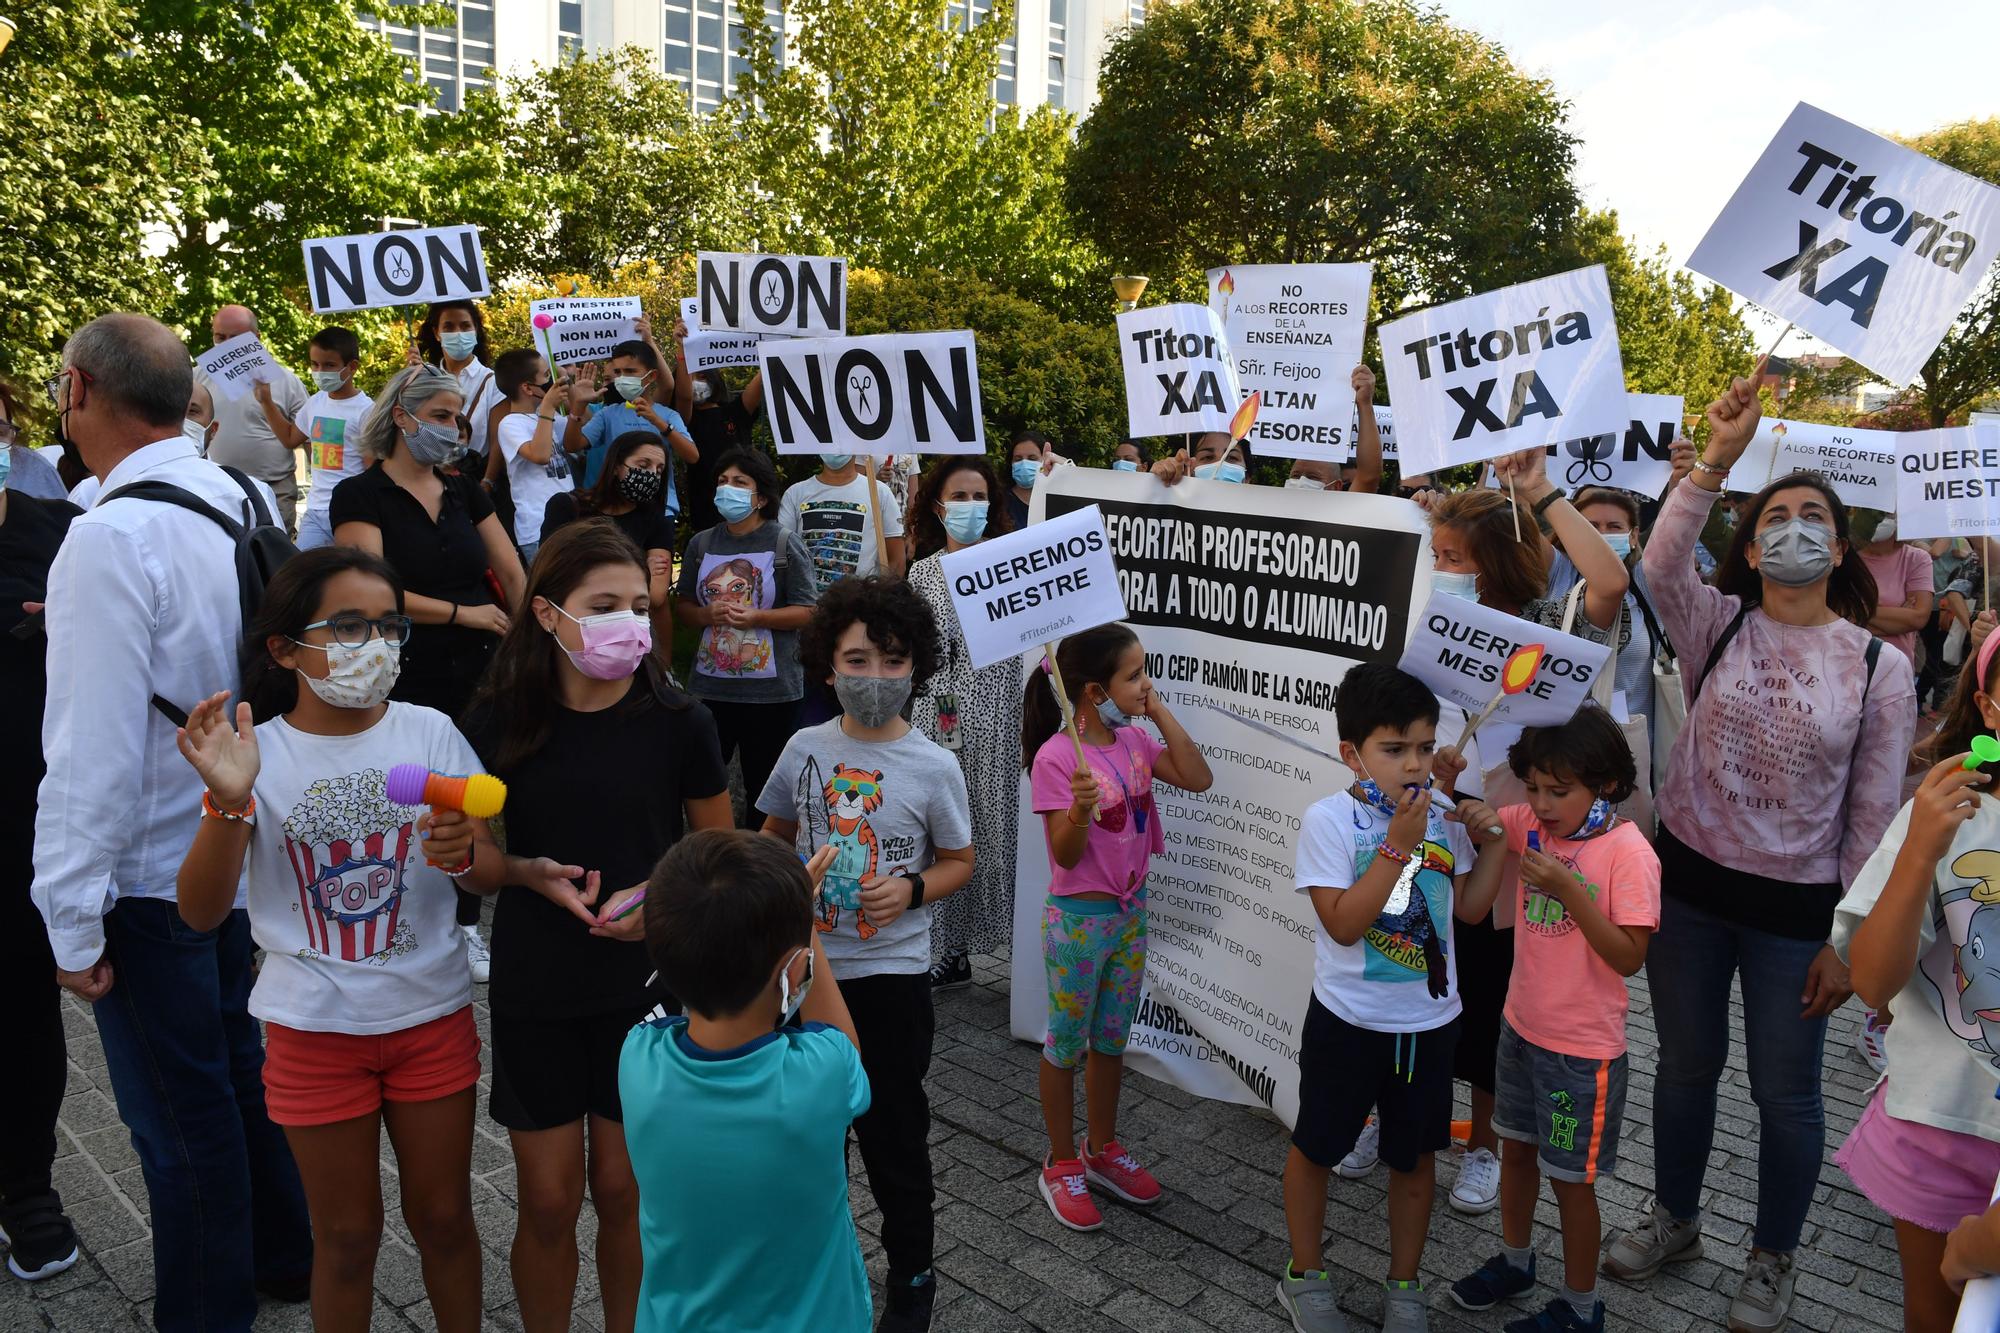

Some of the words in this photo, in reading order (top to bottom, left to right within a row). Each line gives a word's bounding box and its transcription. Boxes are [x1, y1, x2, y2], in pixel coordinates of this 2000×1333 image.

[1787, 141, 1976, 274] Titoría
[309, 232, 483, 309] NON
[1761, 219, 1890, 330] XA
[538, 302, 565, 311] SEN
[569, 300, 633, 309] MESTRES
[701, 258, 842, 331] NON
[1281, 285, 1302, 298] NO
[571, 310, 627, 323] RAMÓN,
[1234, 304, 1243, 314] A
[1245, 304, 1266, 314] LOS
[1268, 302, 1348, 316] RECORTES
[1275, 318, 1290, 328] DE
[1292, 318, 1306, 329] LA
[560, 331, 590, 342] NON
[594, 328, 618, 339] HAI
[709, 340, 739, 350] NON
[742, 340, 760, 349] HA
[1246, 329, 1333, 346] ENSEÑANZA
[1403, 306, 1593, 381] Titoría
[206, 341, 263, 374] QUEREMOS
[224, 356, 266, 381] MESTRE
[698, 353, 760, 367] EDUCACI
[1238, 359, 1267, 376] Sñr.
[1273, 361, 1322, 382] Feijoo
[766, 346, 977, 445] NON
[1156, 370, 1228, 417] XA
[1240, 387, 1317, 411] FLTAN
[1445, 369, 1564, 441] XA
[1249, 420, 1342, 446] FESORES
[1832, 436, 1853, 446] NO
[1785, 443, 1792, 452] A
[1794, 445, 1815, 455] LOS
[1818, 445, 1896, 465] RECORTES
[1822, 459, 1838, 469] DE
[1839, 461, 1853, 471] LA
[1902, 448, 1999, 474] QUERE
[1924, 478, 2000, 501] MEST
[955, 530, 1104, 597] QUEREMOS
[1202, 524, 1361, 587] PROFESORADO
[985, 567, 1091, 622] MESTRE
[1119, 568, 1159, 614] ORA
[1165, 573, 1182, 615] A
[1187, 575, 1238, 626] TODO
[1243, 585, 1259, 629] O
[1263, 588, 1389, 651] ALUMNADO
[1019, 615, 1076, 643] #TitoriaXA
[1144, 652, 1164, 679] NO
[1168, 654, 1199, 683] CEIP
[1202, 659, 1248, 694] RAMÓN
[1252, 670, 1270, 699] DE
[1272, 673, 1291, 704] LA
[1294, 676, 1338, 713] SAGRA
[1437, 647, 1557, 701] MESE
[1763, 677, 1788, 690] OR
[1731, 706, 1746, 717] FOR
[1735, 680, 1759, 696] GO
[1763, 696, 1817, 715] AWAY
[1264, 710, 1321, 735] PERSOA
[1294, 767, 1312, 784] NA
[1707, 769, 1740, 804] YOUR
[1746, 795, 1788, 810] LIFE
[1721, 760, 1774, 786] ENJOY
[1165, 804, 1246, 833] EDUCACIÓN
[1249, 823, 1289, 849] FÍSICA.
[1187, 791, 1230, 809] LEVAR
[1232, 799, 1242, 812] A
[1245, 802, 1282, 824] CABO
[1285, 814, 1301, 831] TO
[881, 836, 915, 850] WILD
[885, 846, 915, 862] SURF
[1163, 831, 1182, 845] AS
[1186, 834, 1248, 861] MESTRAS
[1251, 852, 1295, 881] ESPECIA
[318, 859, 402, 912] POP!
[1181, 854, 1273, 894] DESENVOLVER.
[1146, 870, 1251, 912] OMPROMETIDOS
[1252, 901, 1270, 920] OS
[1271, 910, 1317, 944] PROXEC
[1167, 894, 1225, 920] CENTRO.
[1526, 893, 1564, 928] UP
[1163, 914, 1223, 947] PODERÁN
[1224, 936, 1244, 959] TER
[1245, 949, 1263, 968] OS
[1368, 929, 1427, 969] SURFING
[1160, 979, 1178, 997] UN
[1177, 988, 1255, 1038] DESCUBERTO
[1189, 972, 1208, 990] OU
[1207, 983, 1265, 1022] AUSENCIA
[1266, 1011, 1294, 1036] DUN
[1129, 1031, 1193, 1058] RAMÓN
[1197, 1046, 1220, 1064] DE
[1549, 1112, 1578, 1151] H
